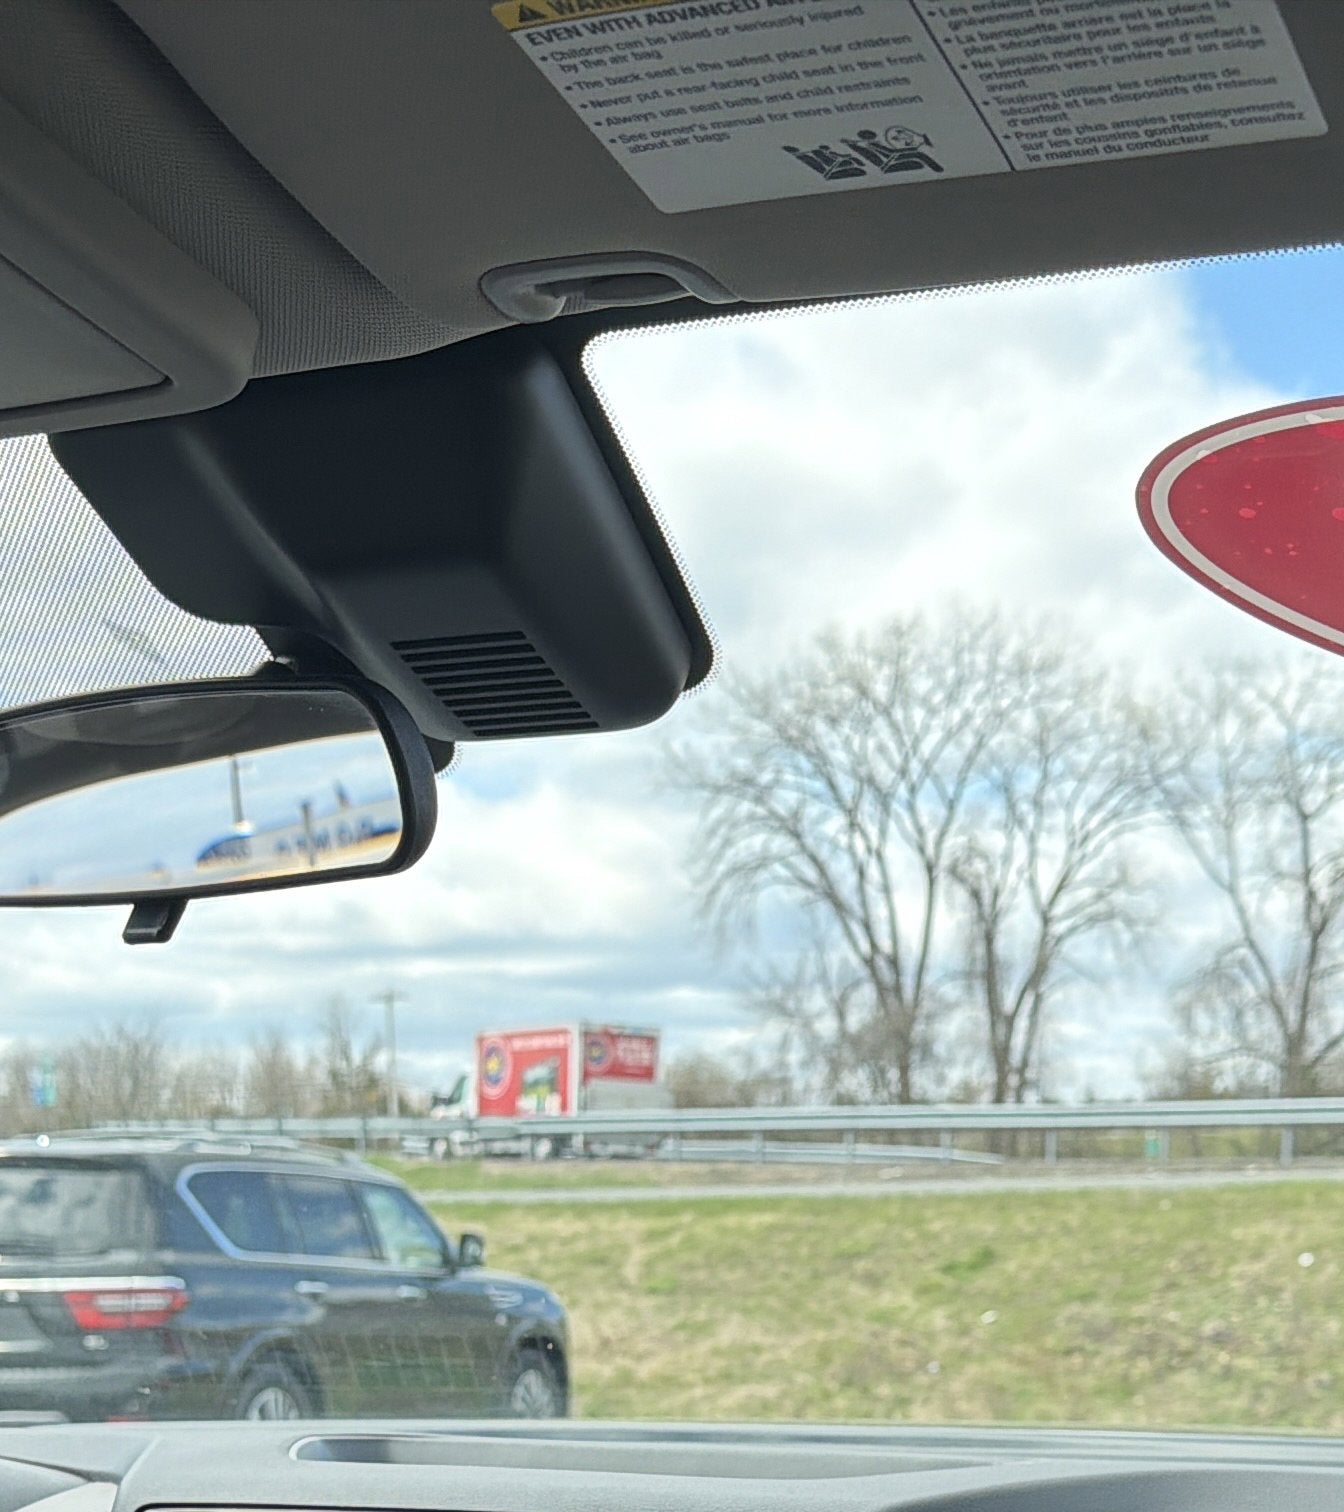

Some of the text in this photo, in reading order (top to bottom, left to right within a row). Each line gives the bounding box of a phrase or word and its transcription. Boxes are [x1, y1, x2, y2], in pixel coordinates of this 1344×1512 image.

[525, 26, 583, 46] EVEN
[582, 16, 643, 36] WITH
[550, 5, 864, 60] Children can be killed or seriously injured
